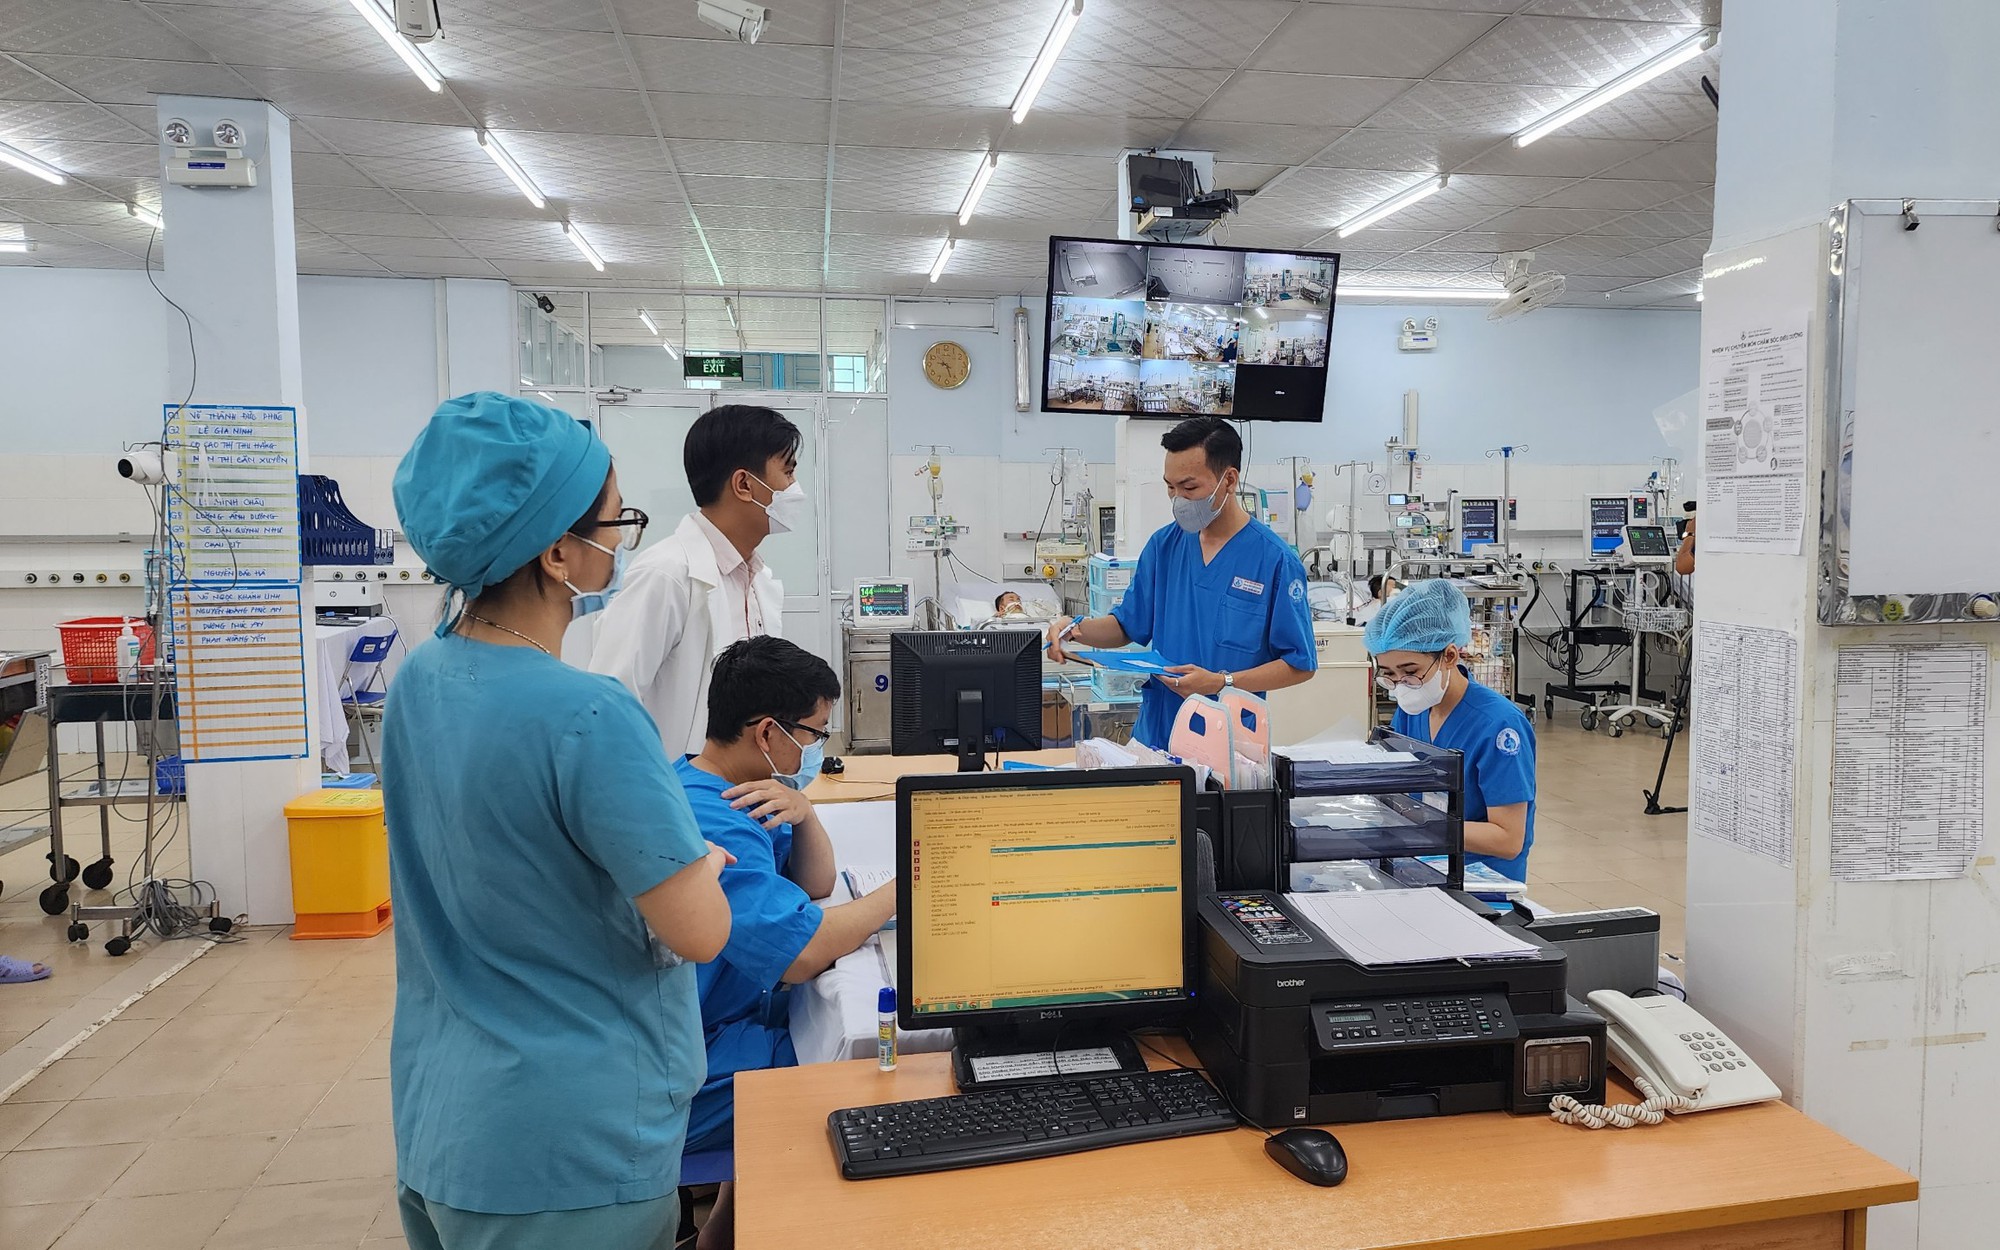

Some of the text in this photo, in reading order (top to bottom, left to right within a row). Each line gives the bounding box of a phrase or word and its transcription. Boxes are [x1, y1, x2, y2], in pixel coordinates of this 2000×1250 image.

[703, 364, 726, 373] EXIT
[168, 426, 180, 434] G2
[861, 588, 874, 596] 144
[875, 675, 889, 692] 9
[1276, 979, 1306, 988] brother
[1040, 1010, 1063, 1019] DELL
